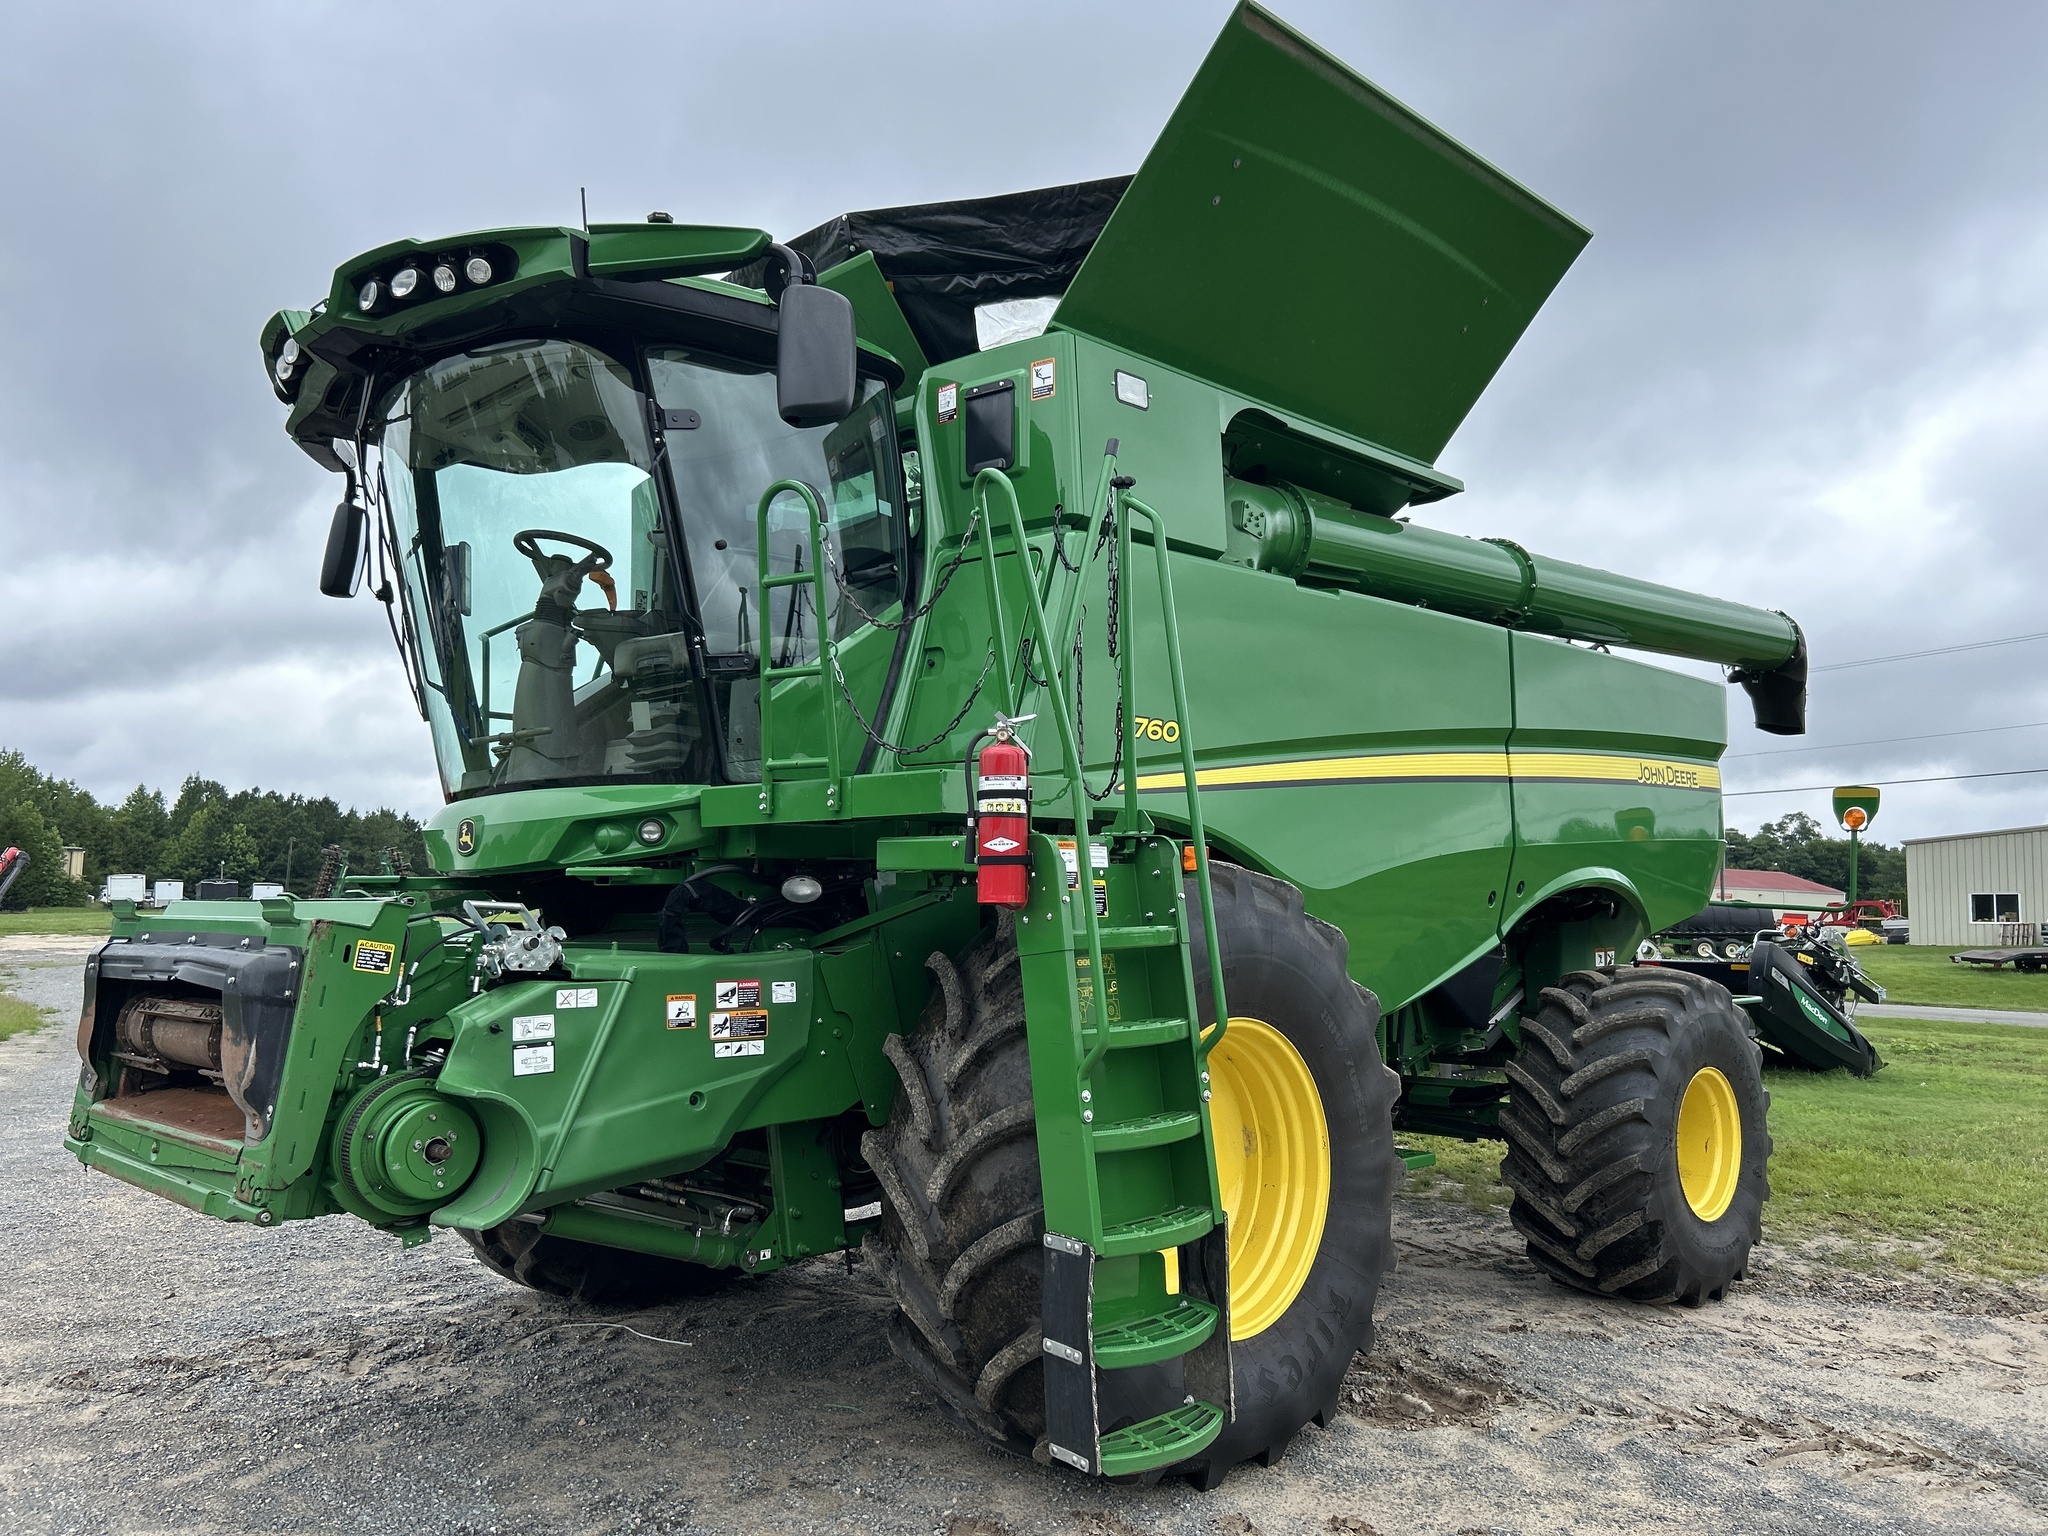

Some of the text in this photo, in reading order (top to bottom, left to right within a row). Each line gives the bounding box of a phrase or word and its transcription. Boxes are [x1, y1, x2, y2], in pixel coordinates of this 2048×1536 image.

[1134, 714, 1180, 743] 760
[1637, 762, 1699, 788] JOHN DEERE
[364, 941, 394, 951] CAUTION
[1800, 996, 1828, 1025] MacDon
